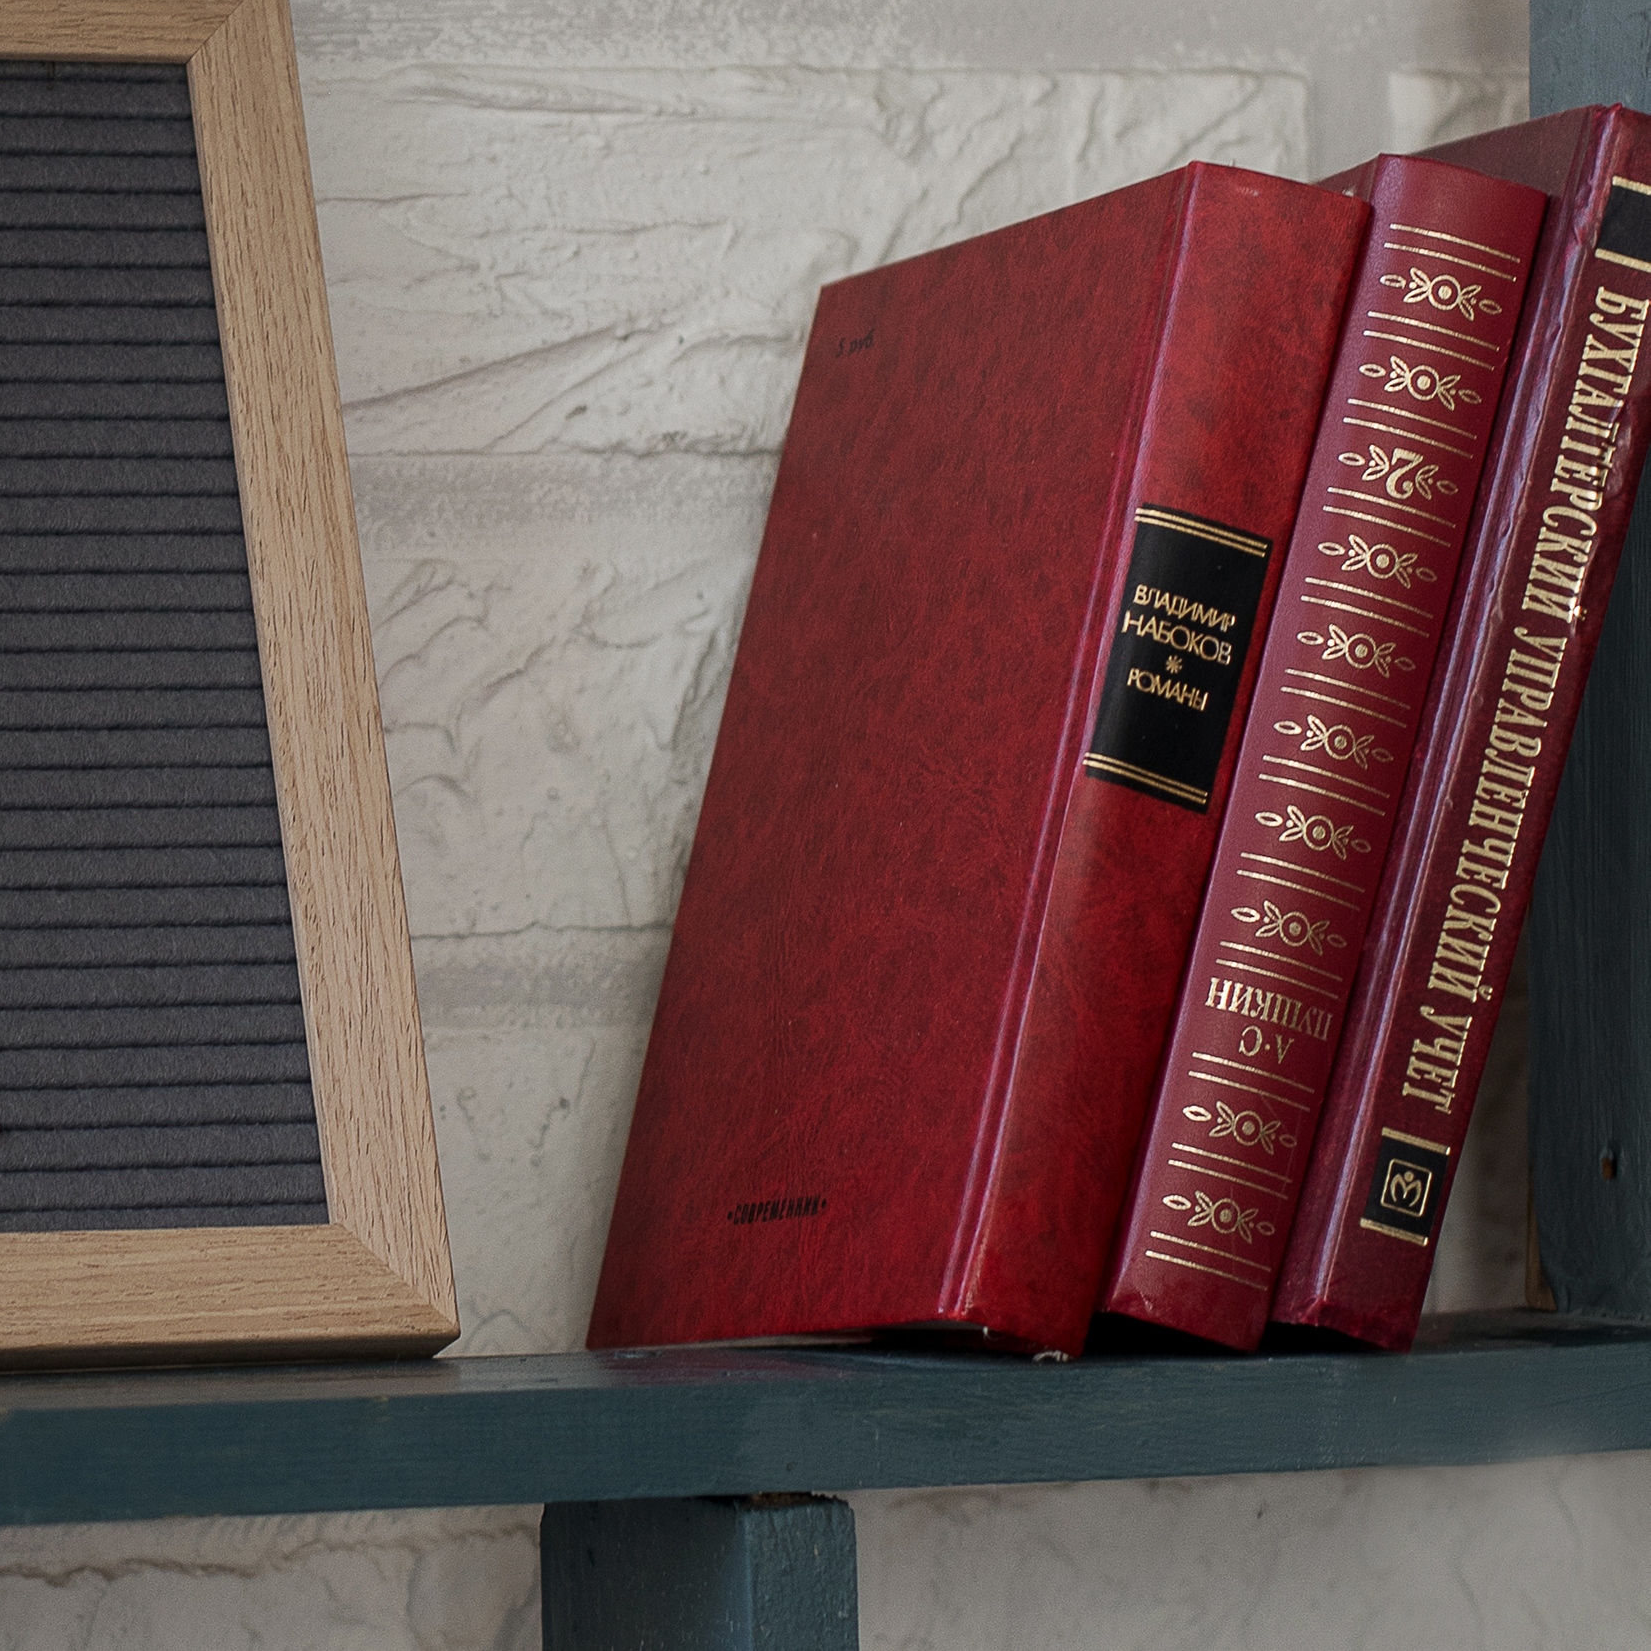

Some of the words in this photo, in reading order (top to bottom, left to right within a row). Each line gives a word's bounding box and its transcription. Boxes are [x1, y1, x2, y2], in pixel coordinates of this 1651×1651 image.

[1521, 286, 1650, 624] БУХГАЛТЕРСКИЙ
[1121, 610, 1232, 665] НАБОКОВ
[1133, 584, 1236, 632] ВЛАДИМИР
[1127, 668, 1209, 711] РОМАНЫ
[1427, 626, 1568, 1003] УПРАВЛЕНЧЕСКИЙ
[1205, 977, 1333, 1041] ПУШКИН
[1402, 1005, 1473, 1115] УЧЕТ
